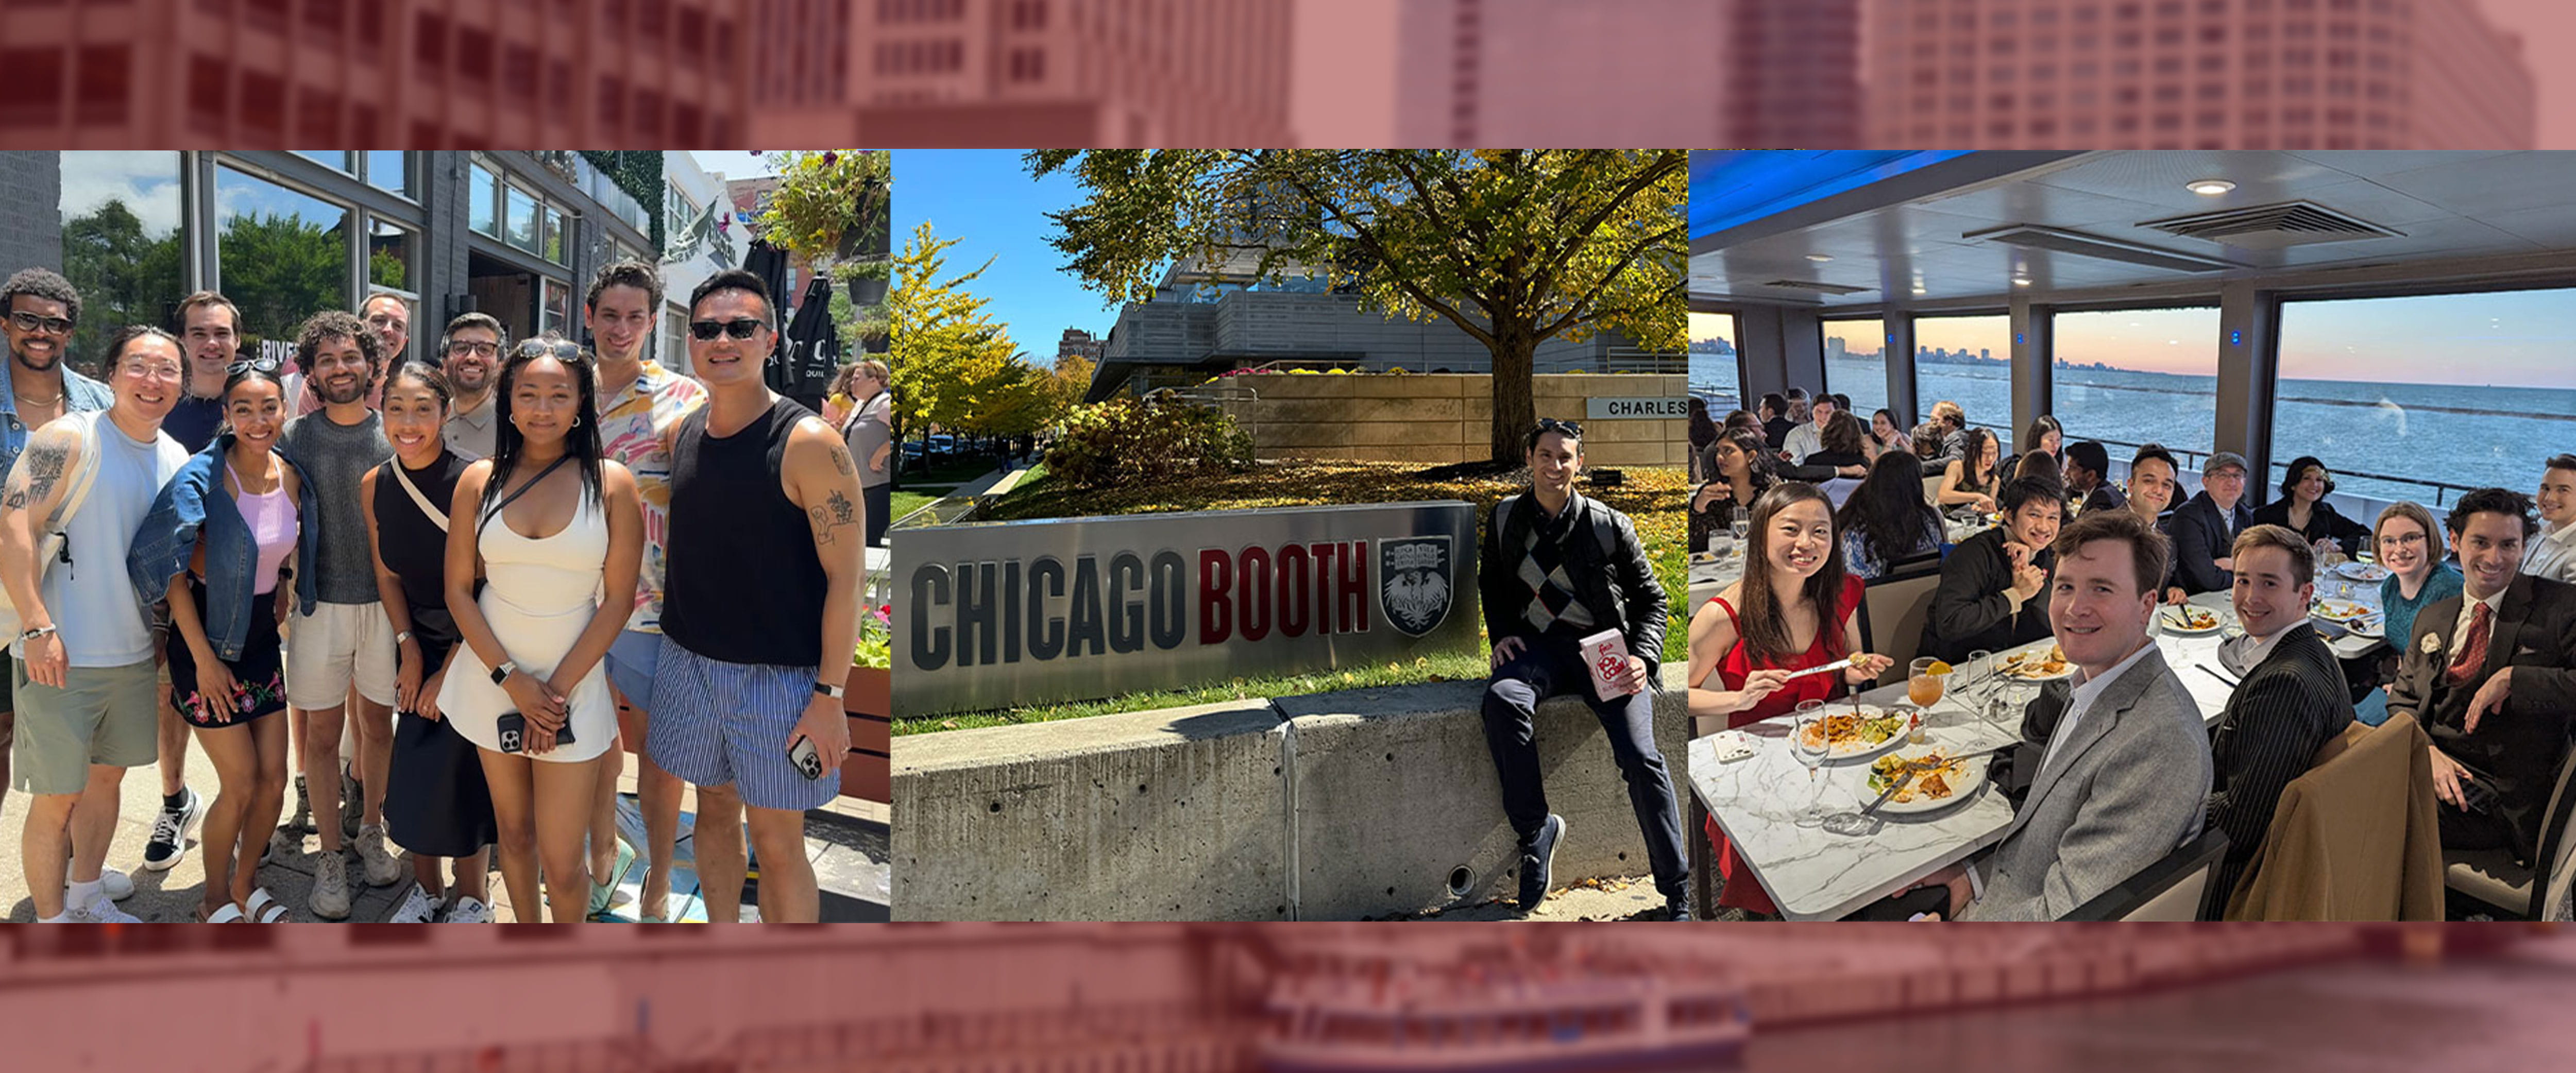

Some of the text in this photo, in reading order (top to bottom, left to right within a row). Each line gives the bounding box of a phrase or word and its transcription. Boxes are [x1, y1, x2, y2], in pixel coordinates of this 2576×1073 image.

[1608, 401, 1687, 415] CHARLES
[911, 540, 1369, 671] CHICAGO BOOTH
